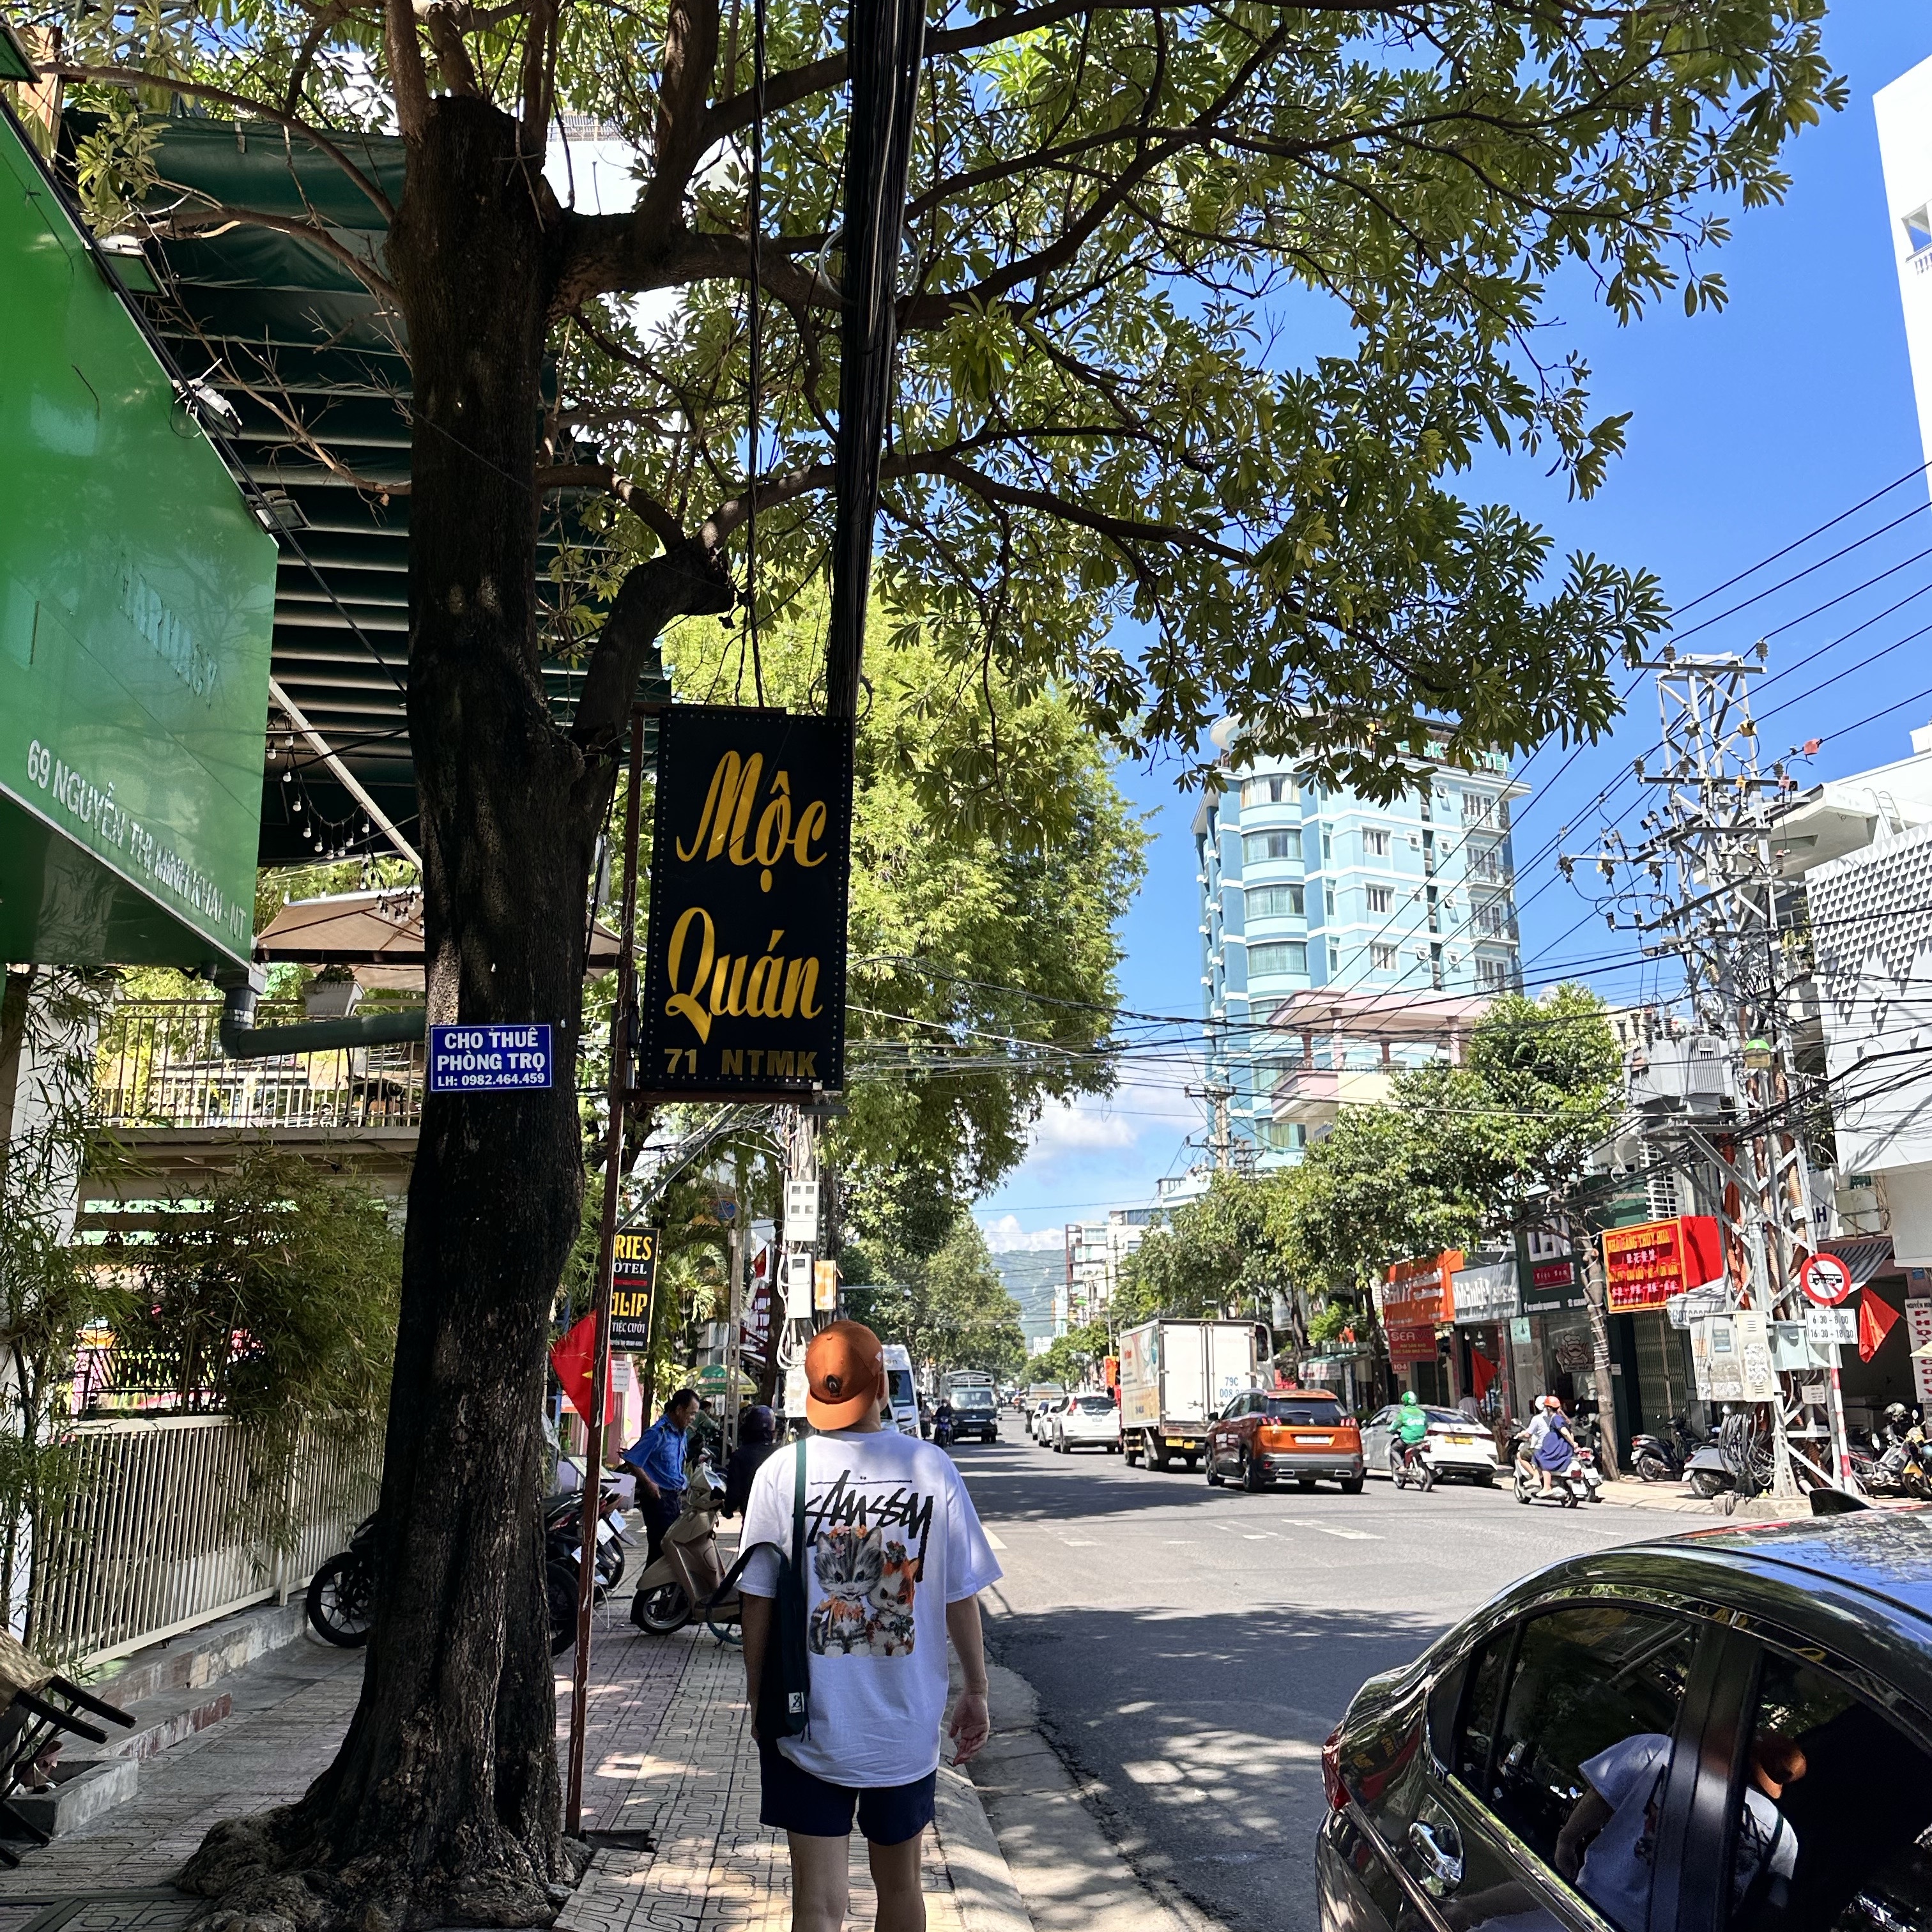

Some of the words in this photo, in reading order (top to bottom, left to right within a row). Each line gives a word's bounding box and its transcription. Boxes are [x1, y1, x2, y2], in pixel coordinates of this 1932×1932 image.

[676, 749, 829, 894] Mộc
[27, 739, 50, 789] 69
[52, 758, 125, 849] NGUYỄN
[128, 818, 153, 880] THỊ
[154, 841, 191, 899] MINH
[190, 870, 224, 924] KHAI
[229, 900, 247, 940] NT
[664, 906, 824, 1045] Quán
[445, 1032, 484, 1050] CHO
[488, 1027, 539, 1048] THUÊ
[437, 1050, 502, 1071] PHÒNG
[507, 1052, 546, 1072] TRỌ
[664, 1047, 698, 1075] 71
[721, 1048, 818, 1078] NTMK
[438, 1075, 458, 1087] LH:
[461, 1072, 545, 1086] 0982.464.459
[615, 1234, 652, 1261] RIES
[614, 1262, 647, 1275] OTEL
[1225, 1377, 1238, 1386] 79C
